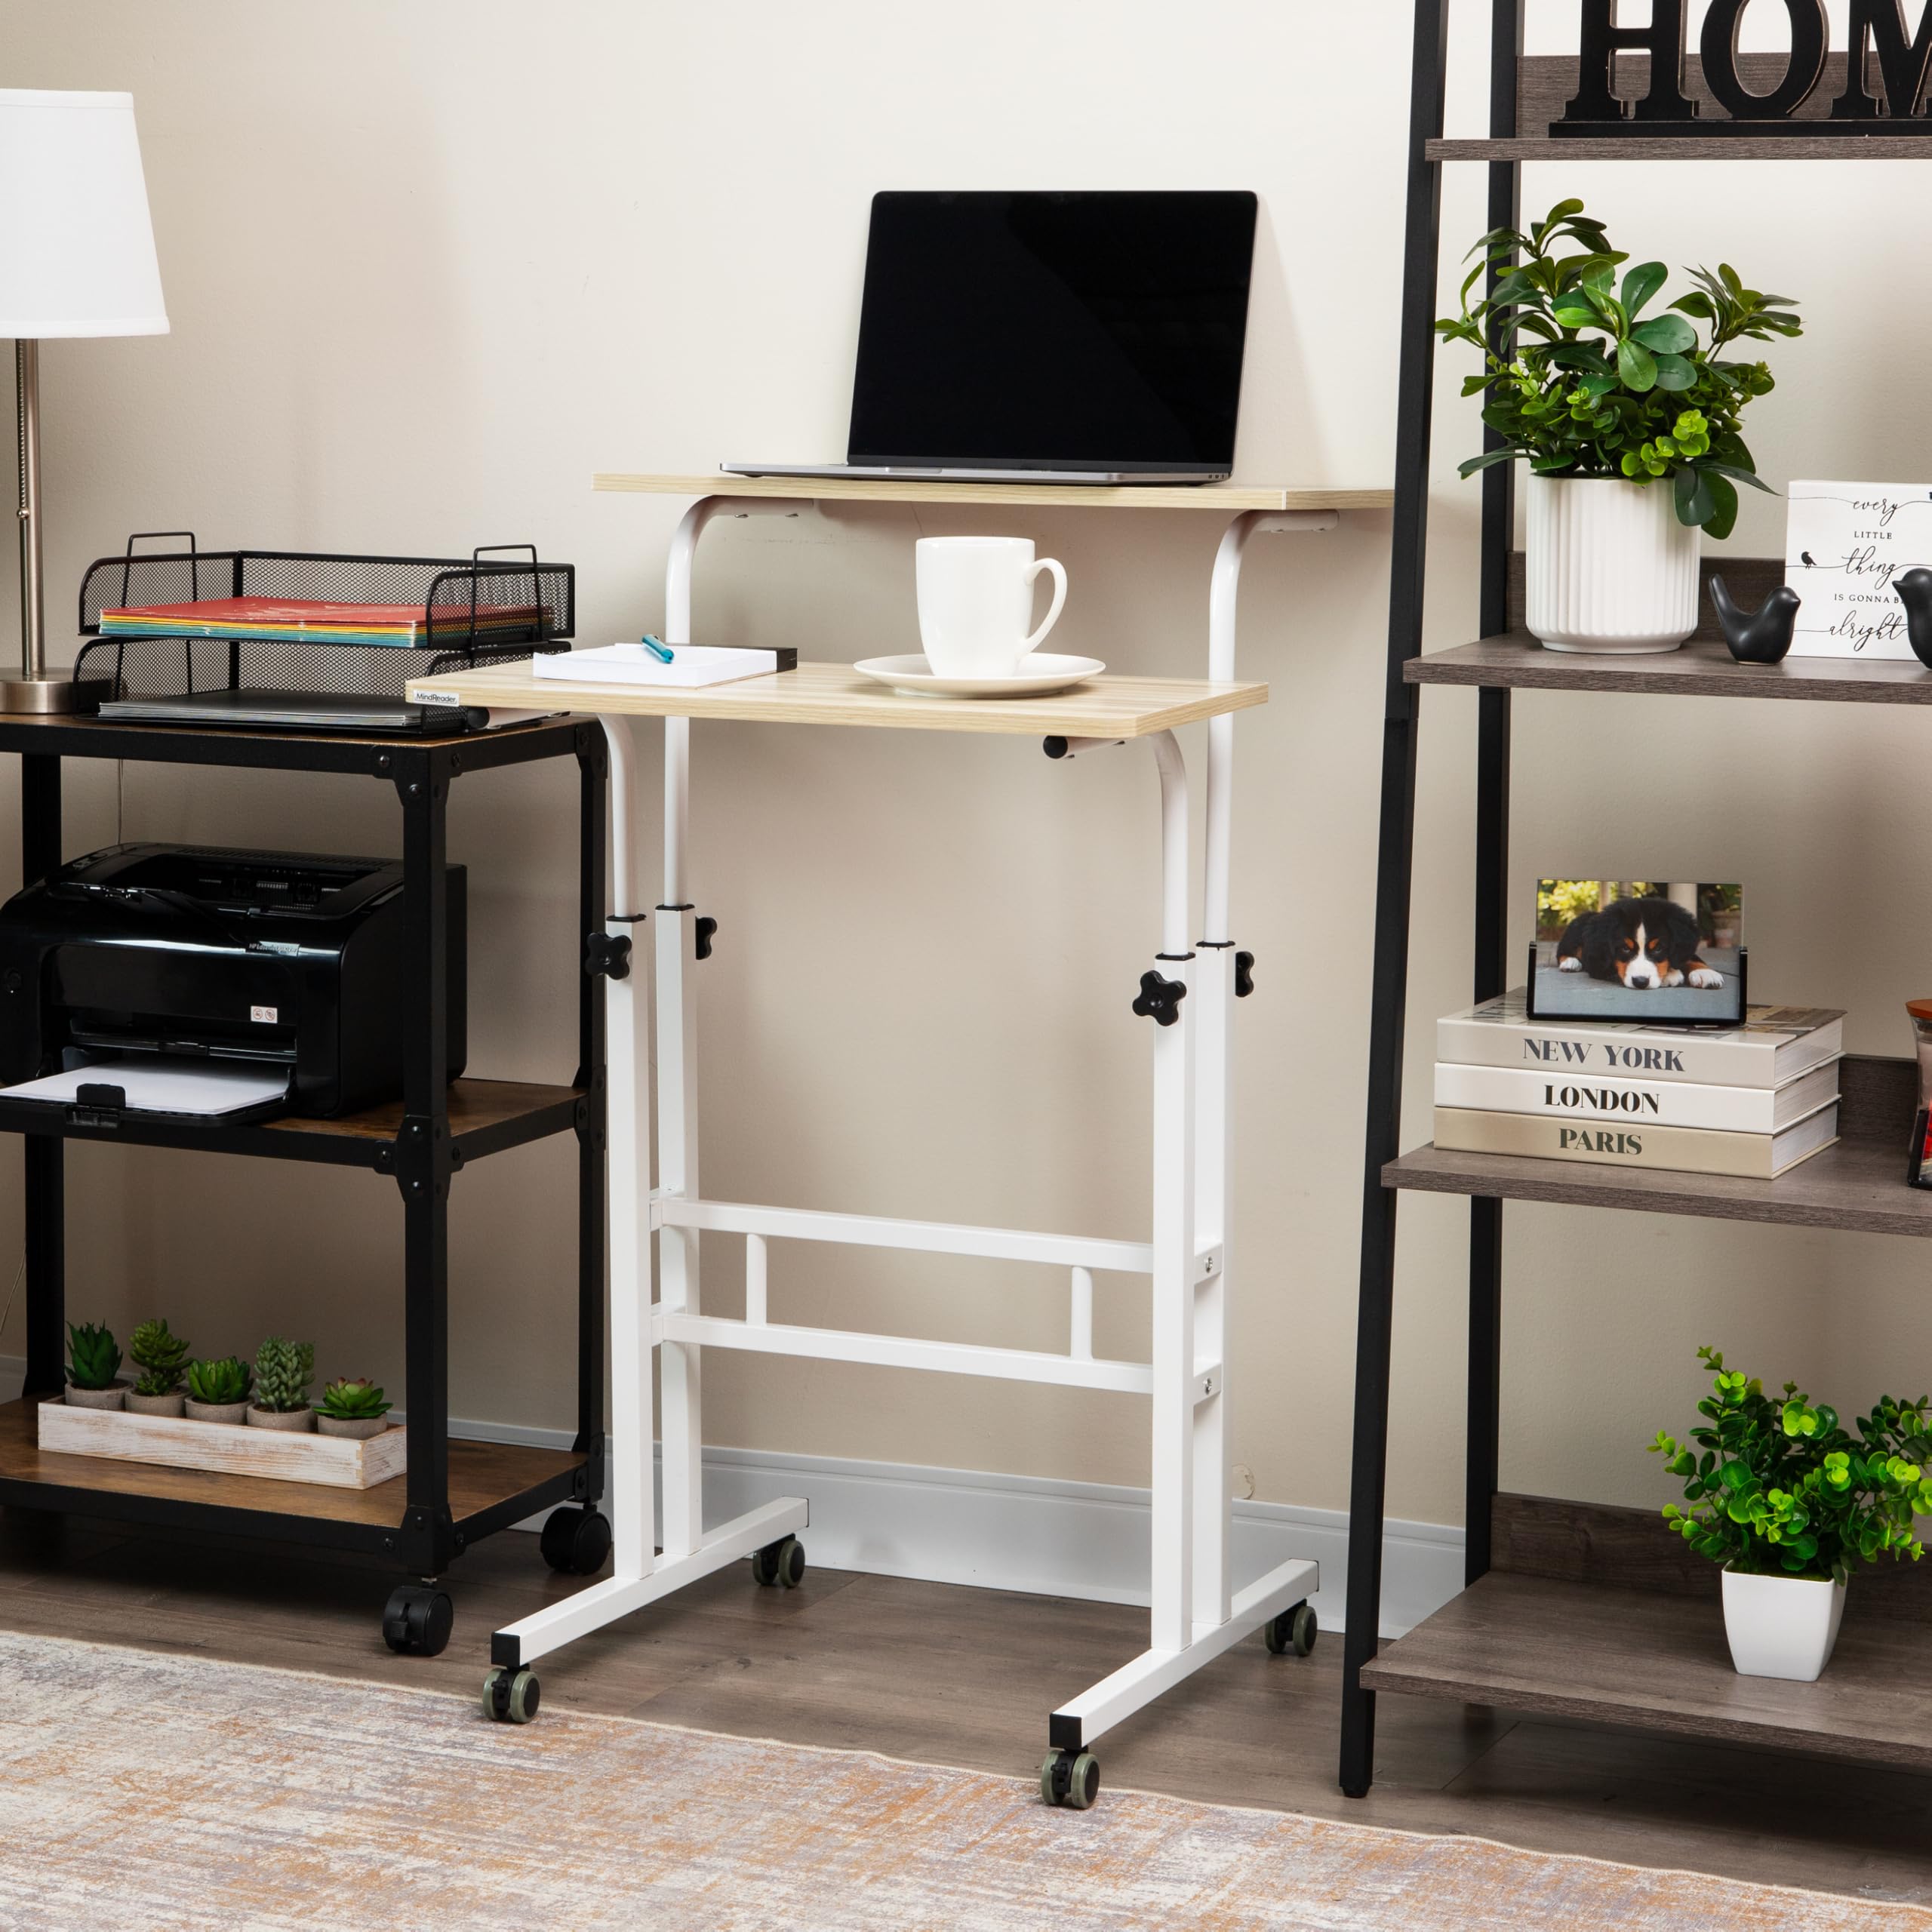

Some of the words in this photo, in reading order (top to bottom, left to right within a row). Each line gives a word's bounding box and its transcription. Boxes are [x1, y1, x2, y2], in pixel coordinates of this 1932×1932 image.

[1853, 498, 1899, 527] every
[1854, 531, 1894, 540] LITTLE
[1841, 546, 1897, 590] thing
[1834, 593, 1844, 601] IS
[1849, 594, 1890, 604] GONNA
[1829, 610, 1908, 651] alright
[417, 693, 457, 703] MindReader
[1523, 1038, 1592, 1063] NEW
[1604, 1044, 1685, 1072] YORK
[1544, 1084, 1660, 1115] LONDON
[1559, 1128, 1642, 1155] PARIS
